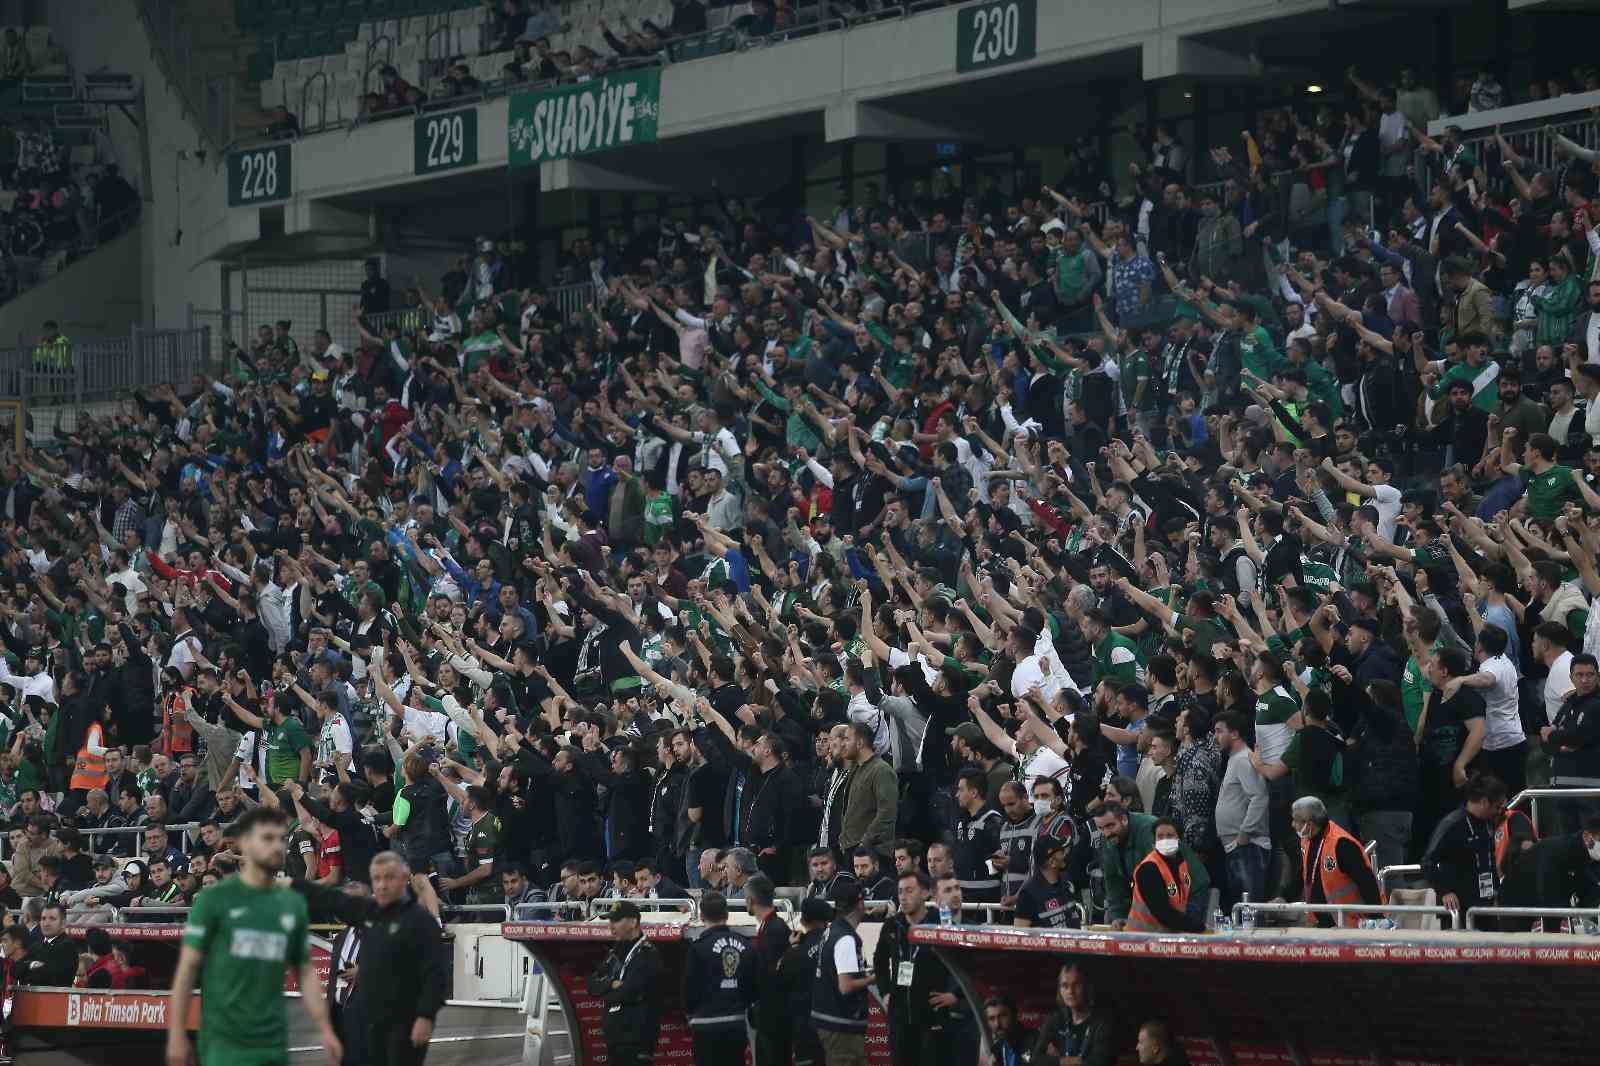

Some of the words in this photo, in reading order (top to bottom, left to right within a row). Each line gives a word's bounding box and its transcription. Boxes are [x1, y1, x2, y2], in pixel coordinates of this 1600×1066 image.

[971, 2, 1020, 63] 230
[426, 114, 465, 168] 229
[530, 77, 638, 161] SUADİYE
[240, 150, 278, 201] 228
[81, 997, 104, 1023] Bitci
[104, 997, 140, 1024] Timsah
[140, 1000, 166, 1025] Park
